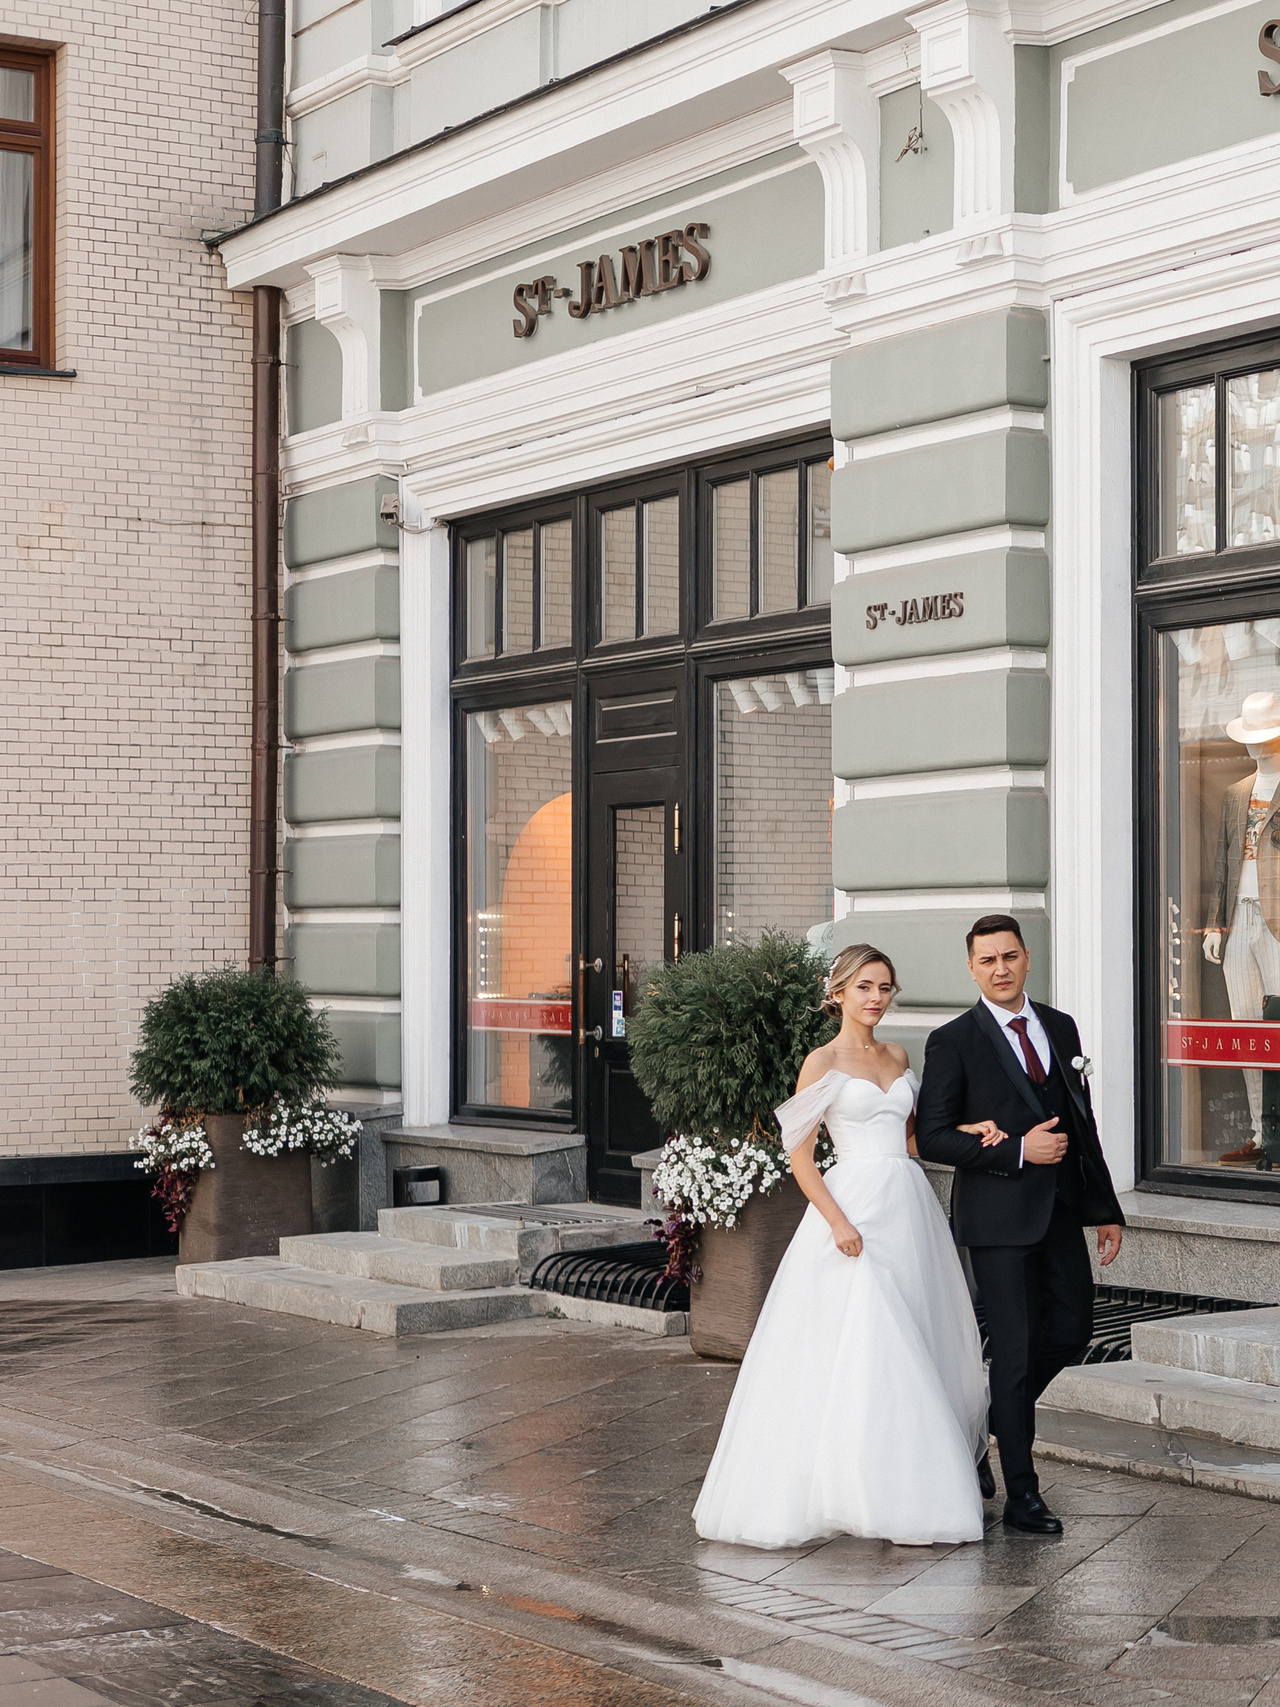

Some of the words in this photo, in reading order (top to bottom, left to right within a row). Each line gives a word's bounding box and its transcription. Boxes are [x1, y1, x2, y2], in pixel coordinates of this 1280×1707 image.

[513, 223, 710, 338] ST-JAMES
[866, 591, 964, 630] ST-JAMES
[1181, 1036, 1271, 1051] ST-JAMES
